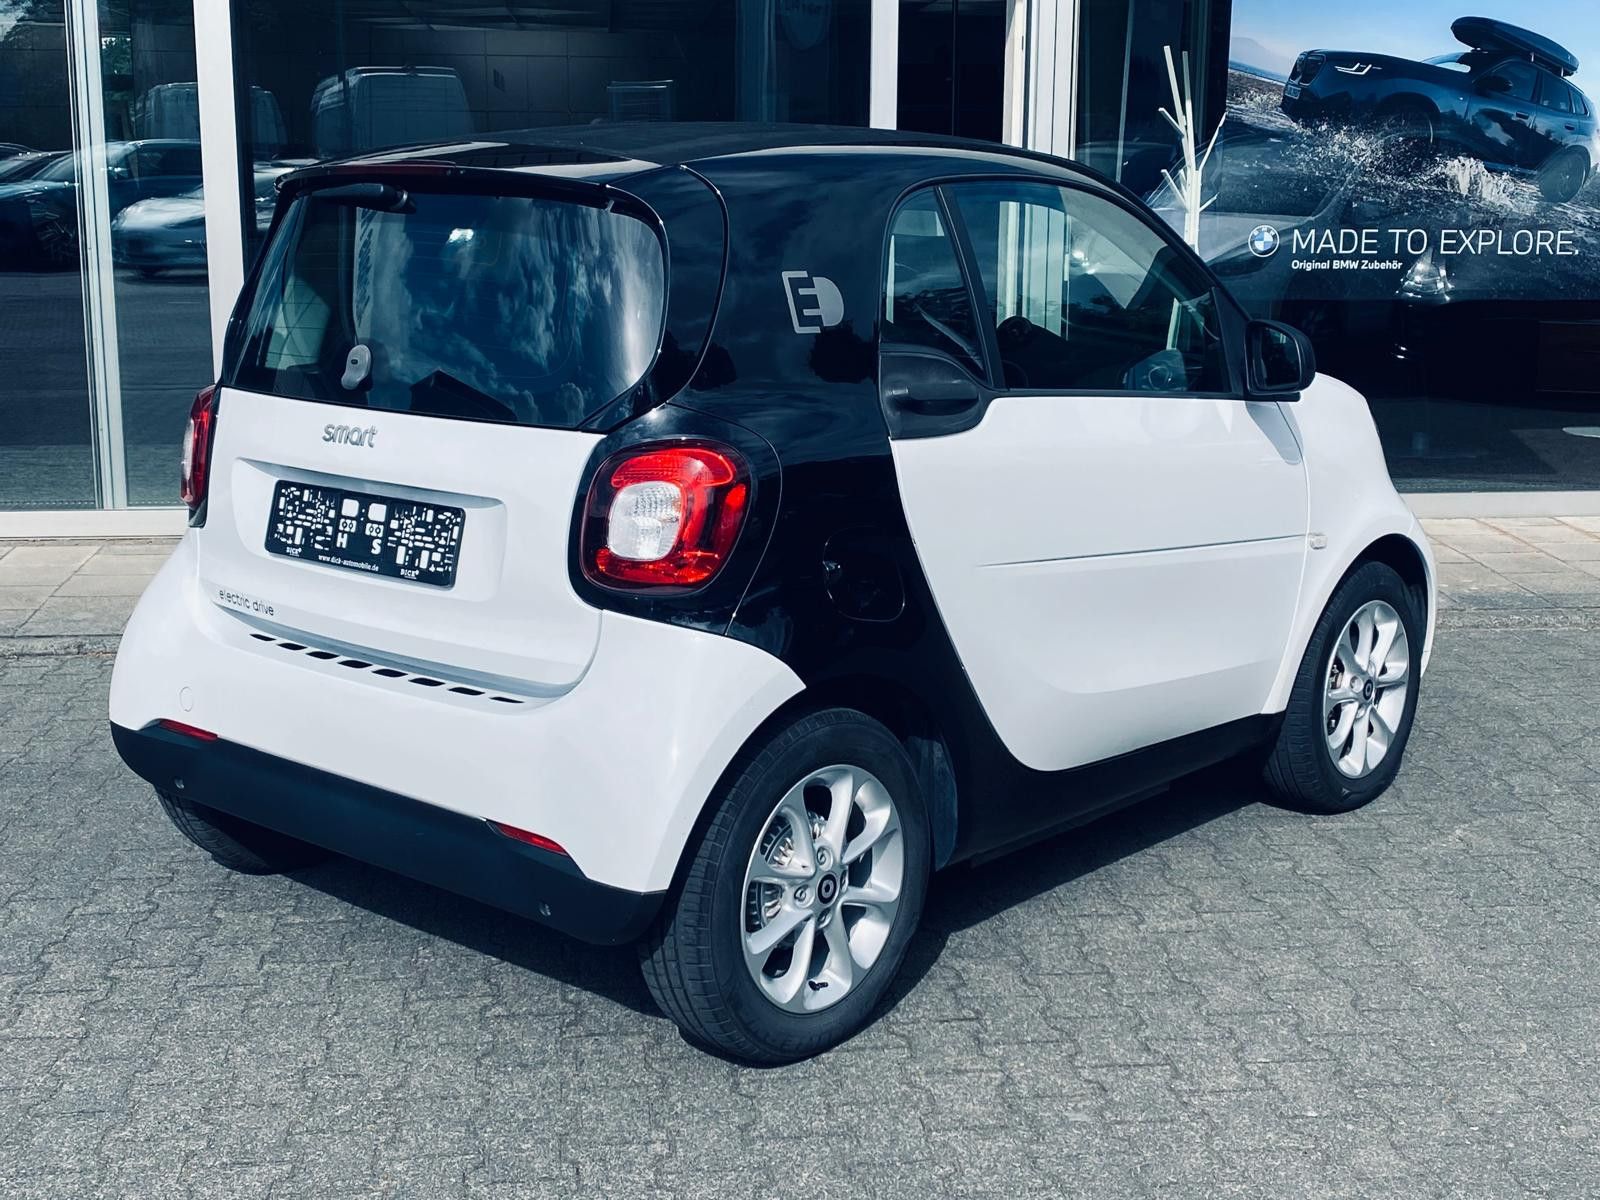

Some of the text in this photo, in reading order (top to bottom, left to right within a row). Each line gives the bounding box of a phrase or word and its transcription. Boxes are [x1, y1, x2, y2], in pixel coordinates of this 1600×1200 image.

[1292, 229, 1579, 256] MADE TO EXPLORE.
[1291, 259, 1403, 271] Original BMW Zubehör
[321, 423, 378, 449] smart
[219, 588, 275, 616] electric drive
